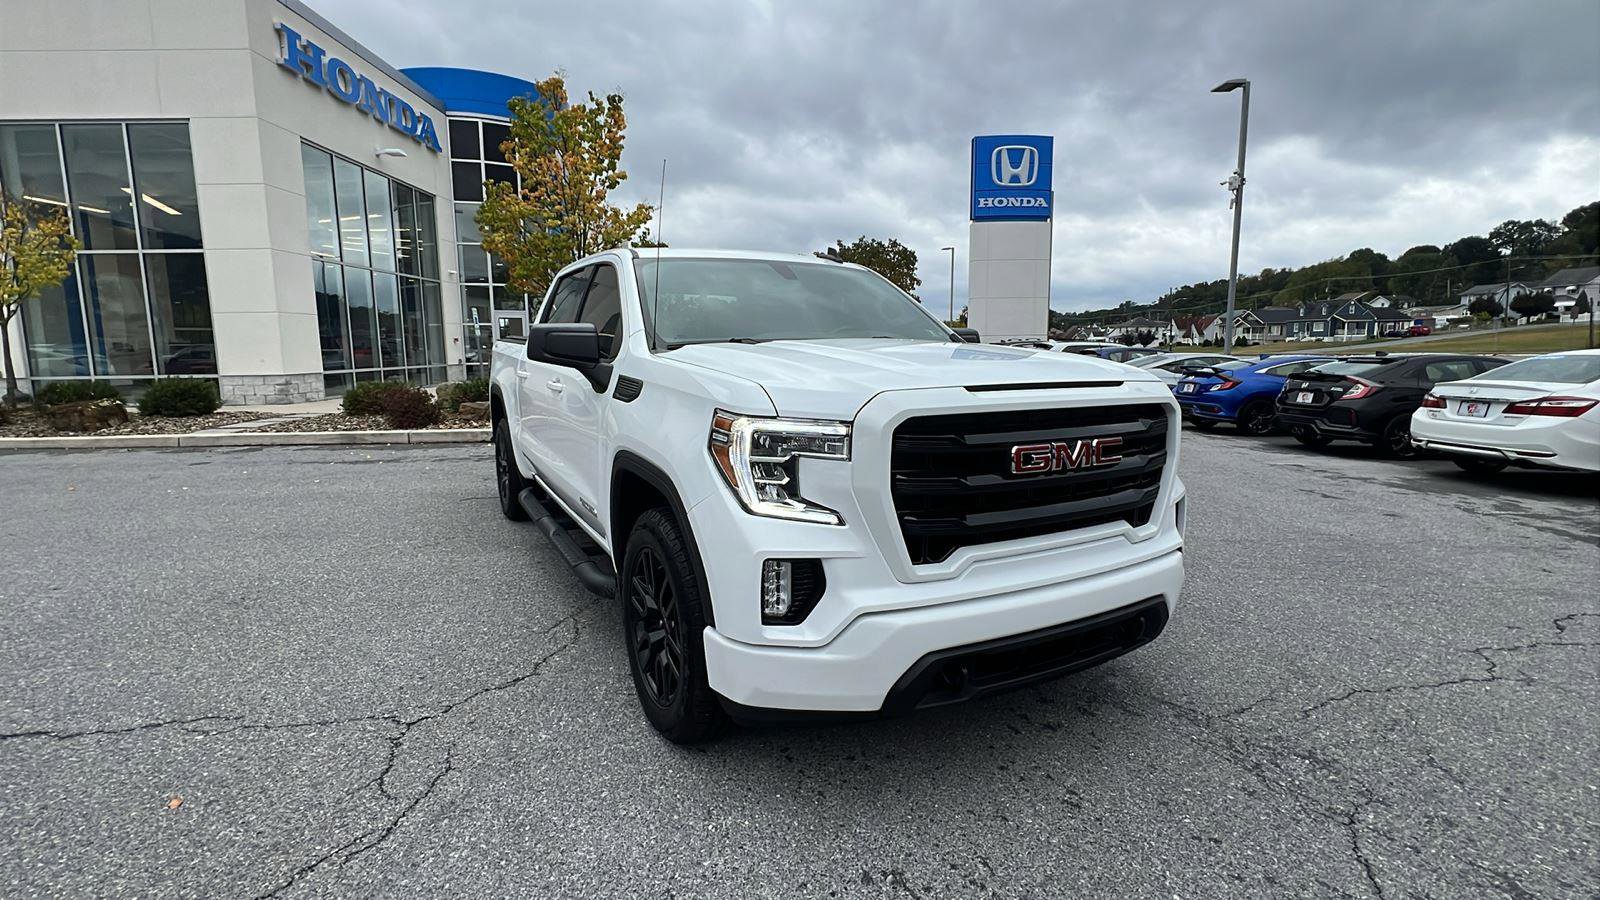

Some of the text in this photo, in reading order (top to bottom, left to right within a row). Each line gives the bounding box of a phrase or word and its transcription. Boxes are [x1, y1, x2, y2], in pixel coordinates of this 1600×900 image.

[274, 22, 442, 153] HONDA
[978, 197, 1048, 208] HONDA
[1011, 437, 1123, 474] GMC
